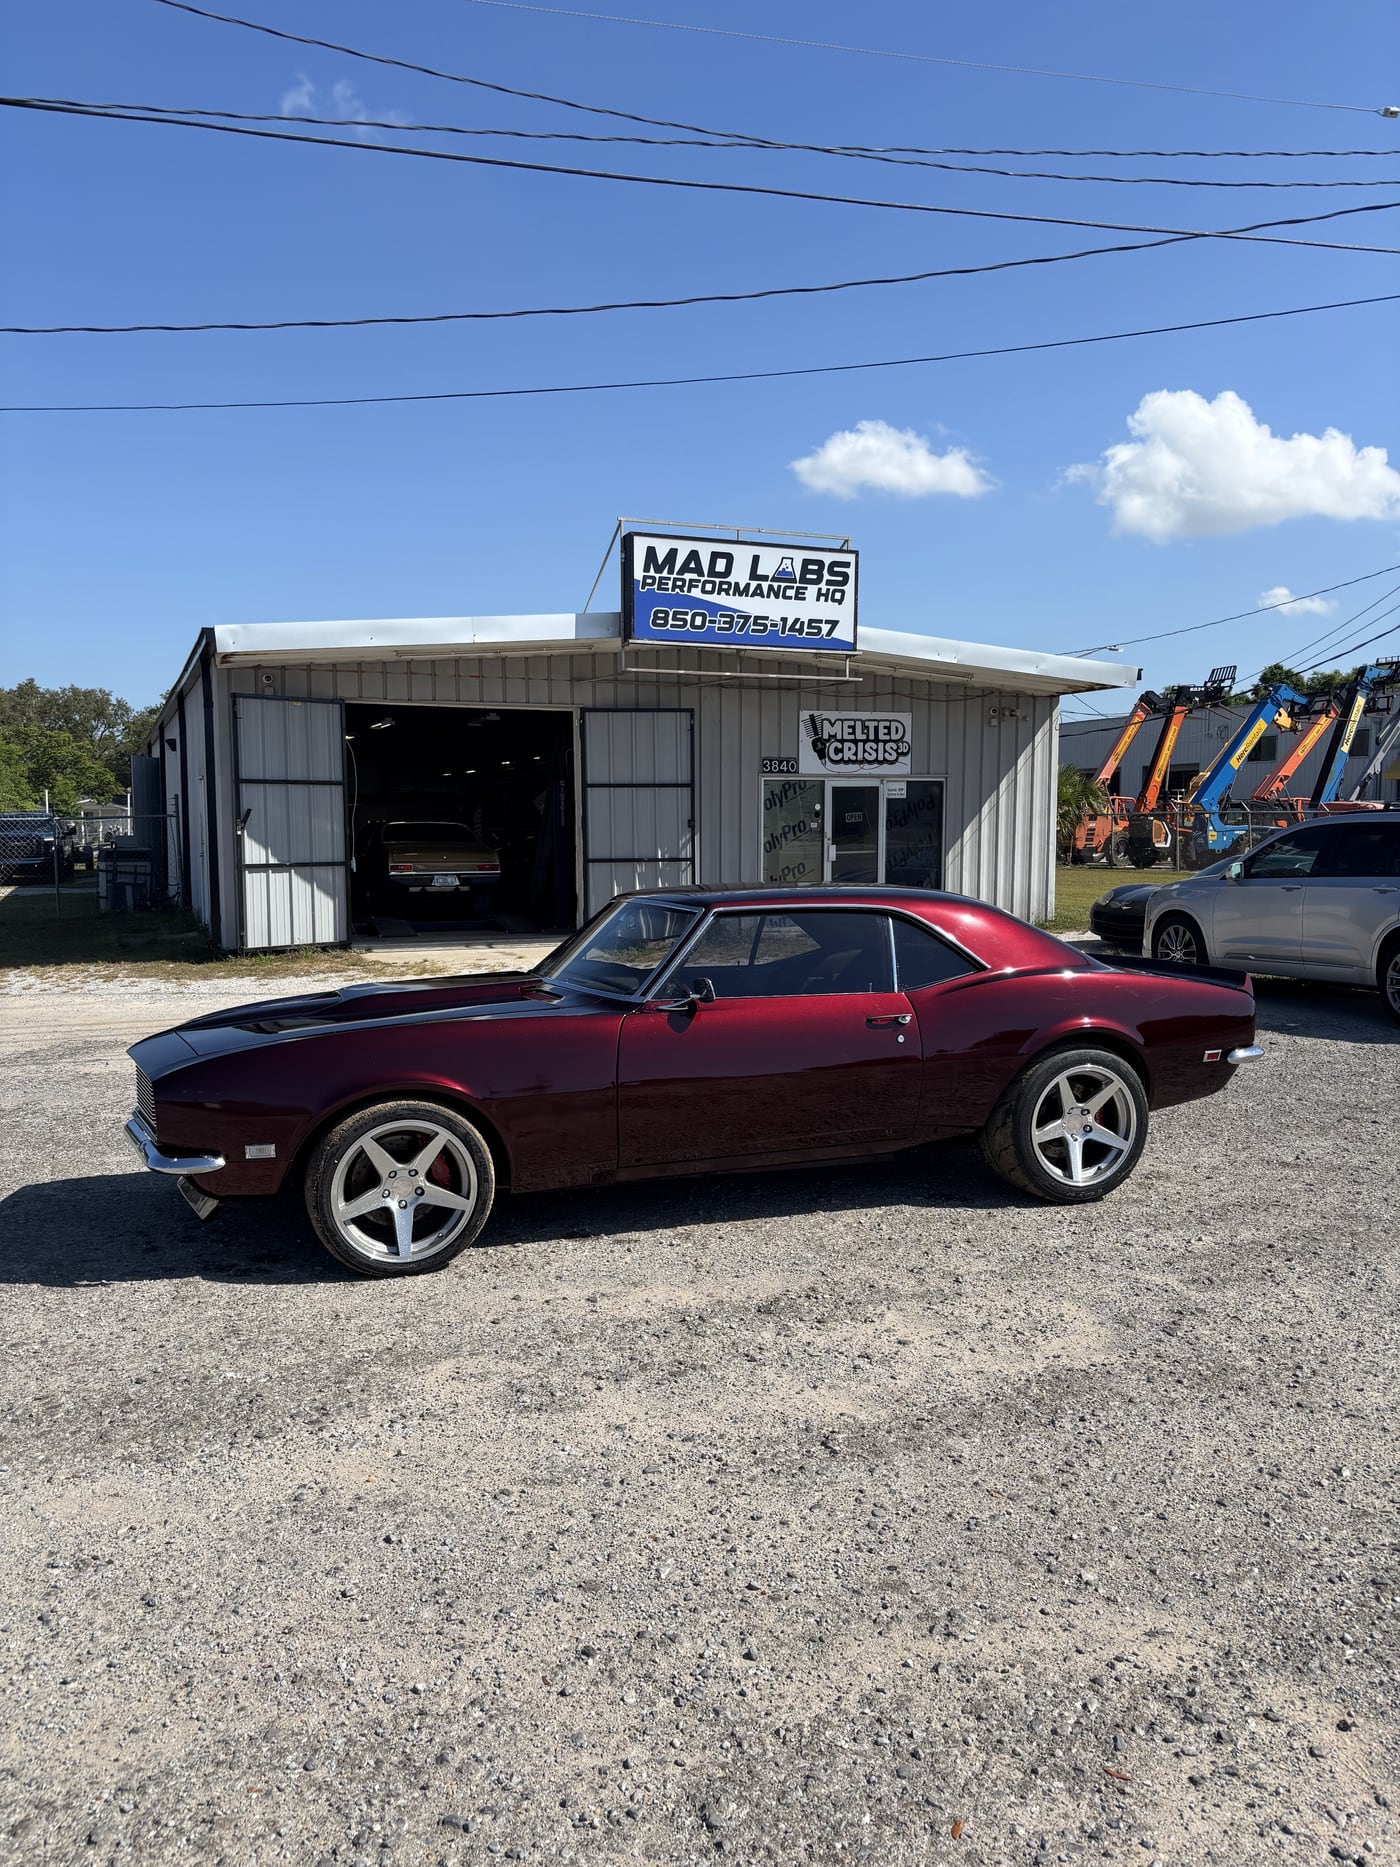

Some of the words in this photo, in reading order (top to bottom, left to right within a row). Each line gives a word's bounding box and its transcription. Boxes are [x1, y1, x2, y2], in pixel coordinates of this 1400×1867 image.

[643, 546, 734, 579] MAD
[749, 554, 851, 587] LABS
[640, 575, 808, 601] PERFORMANCE
[816, 587, 846, 605] HQ
[651, 609, 840, 638] 850-375-1457
[822, 720, 905, 740] MELTED
[828, 742, 898, 761] CRISIS
[897, 742, 909, 753] 3D
[762, 760, 797, 773] 3840
[847, 813, 862, 822] OPEN
